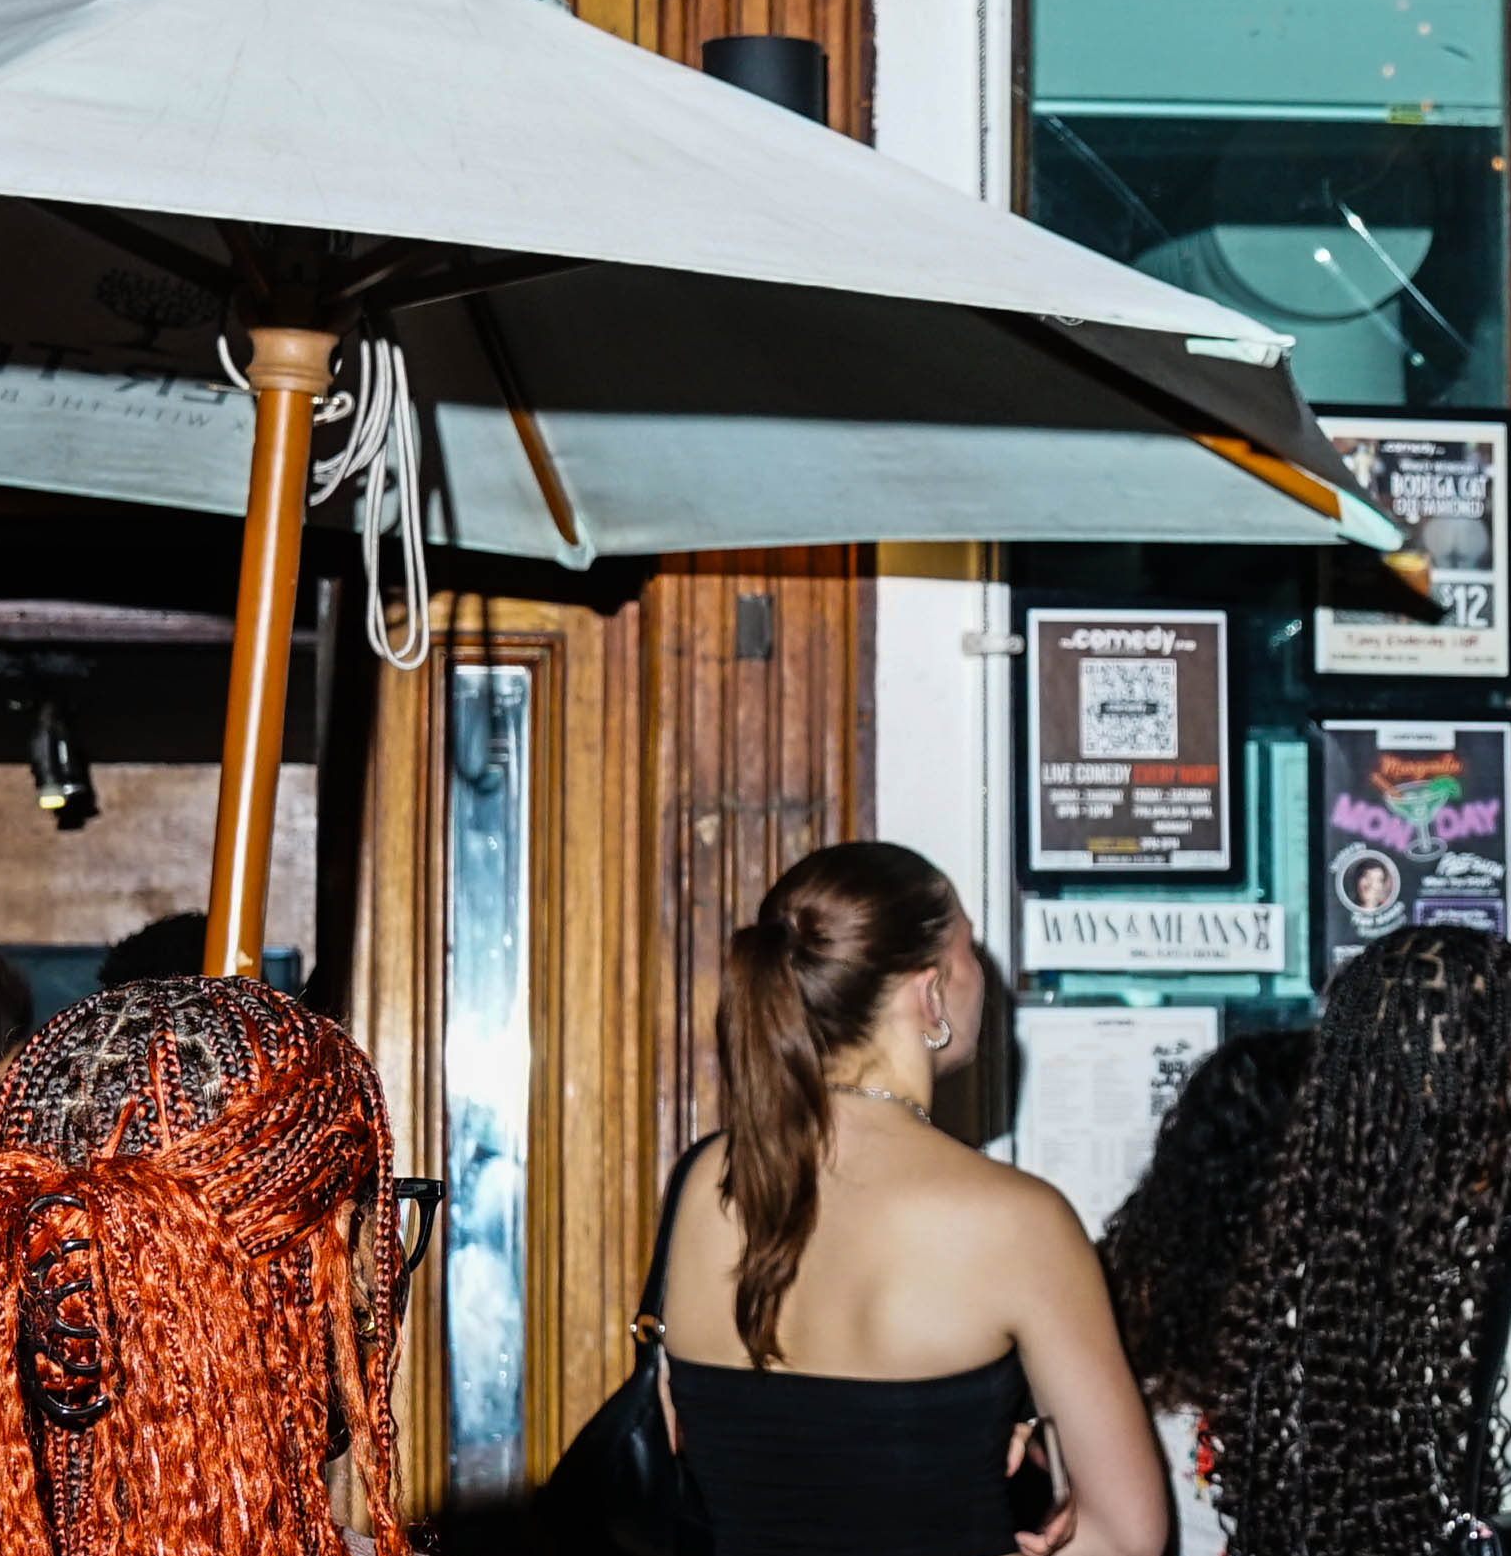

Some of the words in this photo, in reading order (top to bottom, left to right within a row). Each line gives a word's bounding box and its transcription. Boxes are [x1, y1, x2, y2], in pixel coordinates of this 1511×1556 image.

[1440, 584, 1489, 629] $12
[1072, 624, 1177, 657] comedy
[1041, 762, 1073, 786] LIVE
[1075, 762, 1132, 786] COMEDY
[1041, 909, 1120, 943] WAYS
[1149, 912, 1249, 944] MEANS
